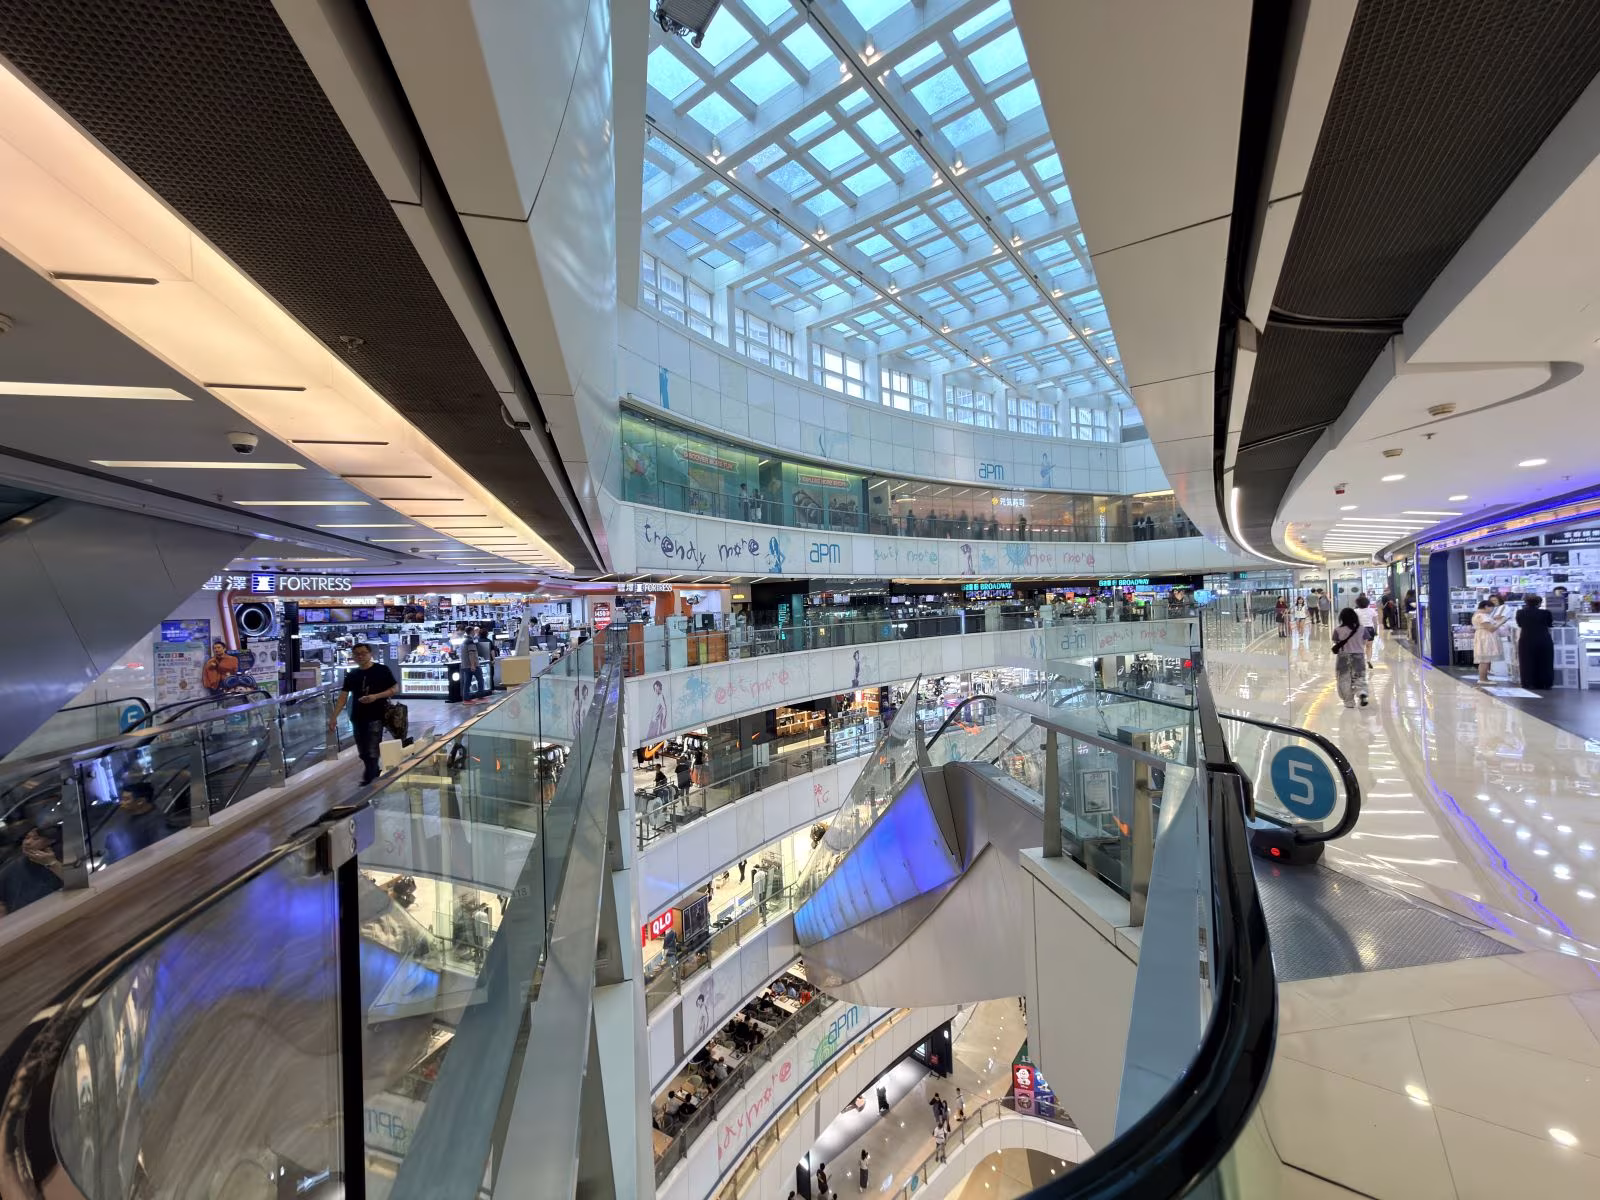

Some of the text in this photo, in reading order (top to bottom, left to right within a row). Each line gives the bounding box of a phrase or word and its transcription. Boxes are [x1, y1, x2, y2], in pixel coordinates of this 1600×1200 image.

[279, 576, 352, 591] FORTRESS
[644, 583, 673, 592] FORTRESS
[980, 582, 1012, 590] BROADWAY
[1288, 760, 1314, 805] 5
[653, 912, 672, 934] QLO
